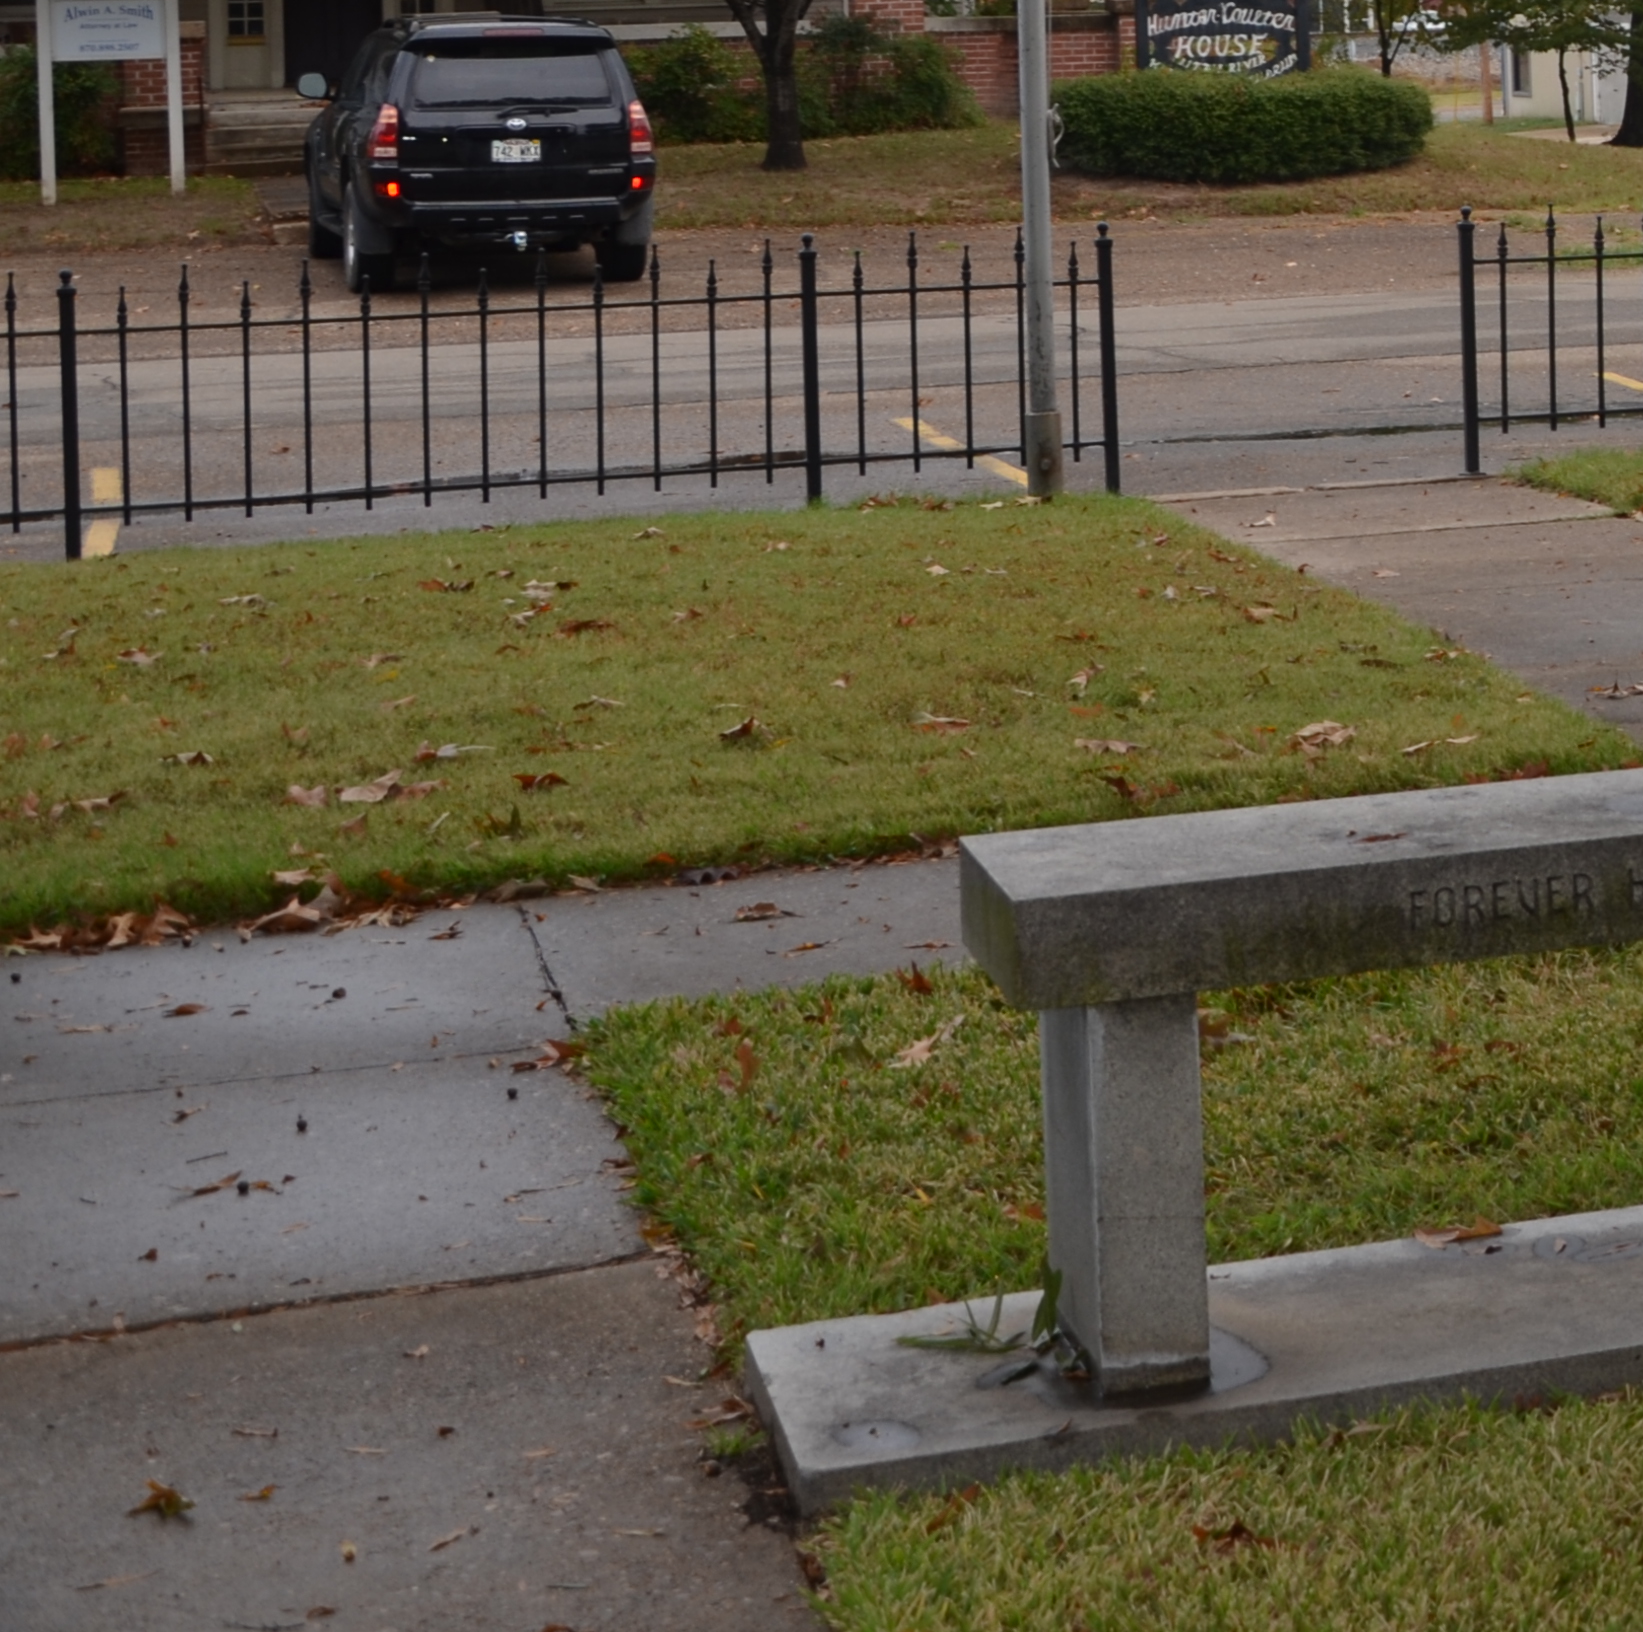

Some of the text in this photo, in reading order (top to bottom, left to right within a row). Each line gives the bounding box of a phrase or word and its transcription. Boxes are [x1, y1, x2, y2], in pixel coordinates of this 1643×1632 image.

[64, 5, 100, 23] Alwin
[118, 4, 154, 21] Smith
[79, 22, 111, 30] Attorney
[1174, 32, 1269, 59] HOUSE
[493, 145, 514, 158] 742
[1407, 872, 1596, 932] FOREVER
